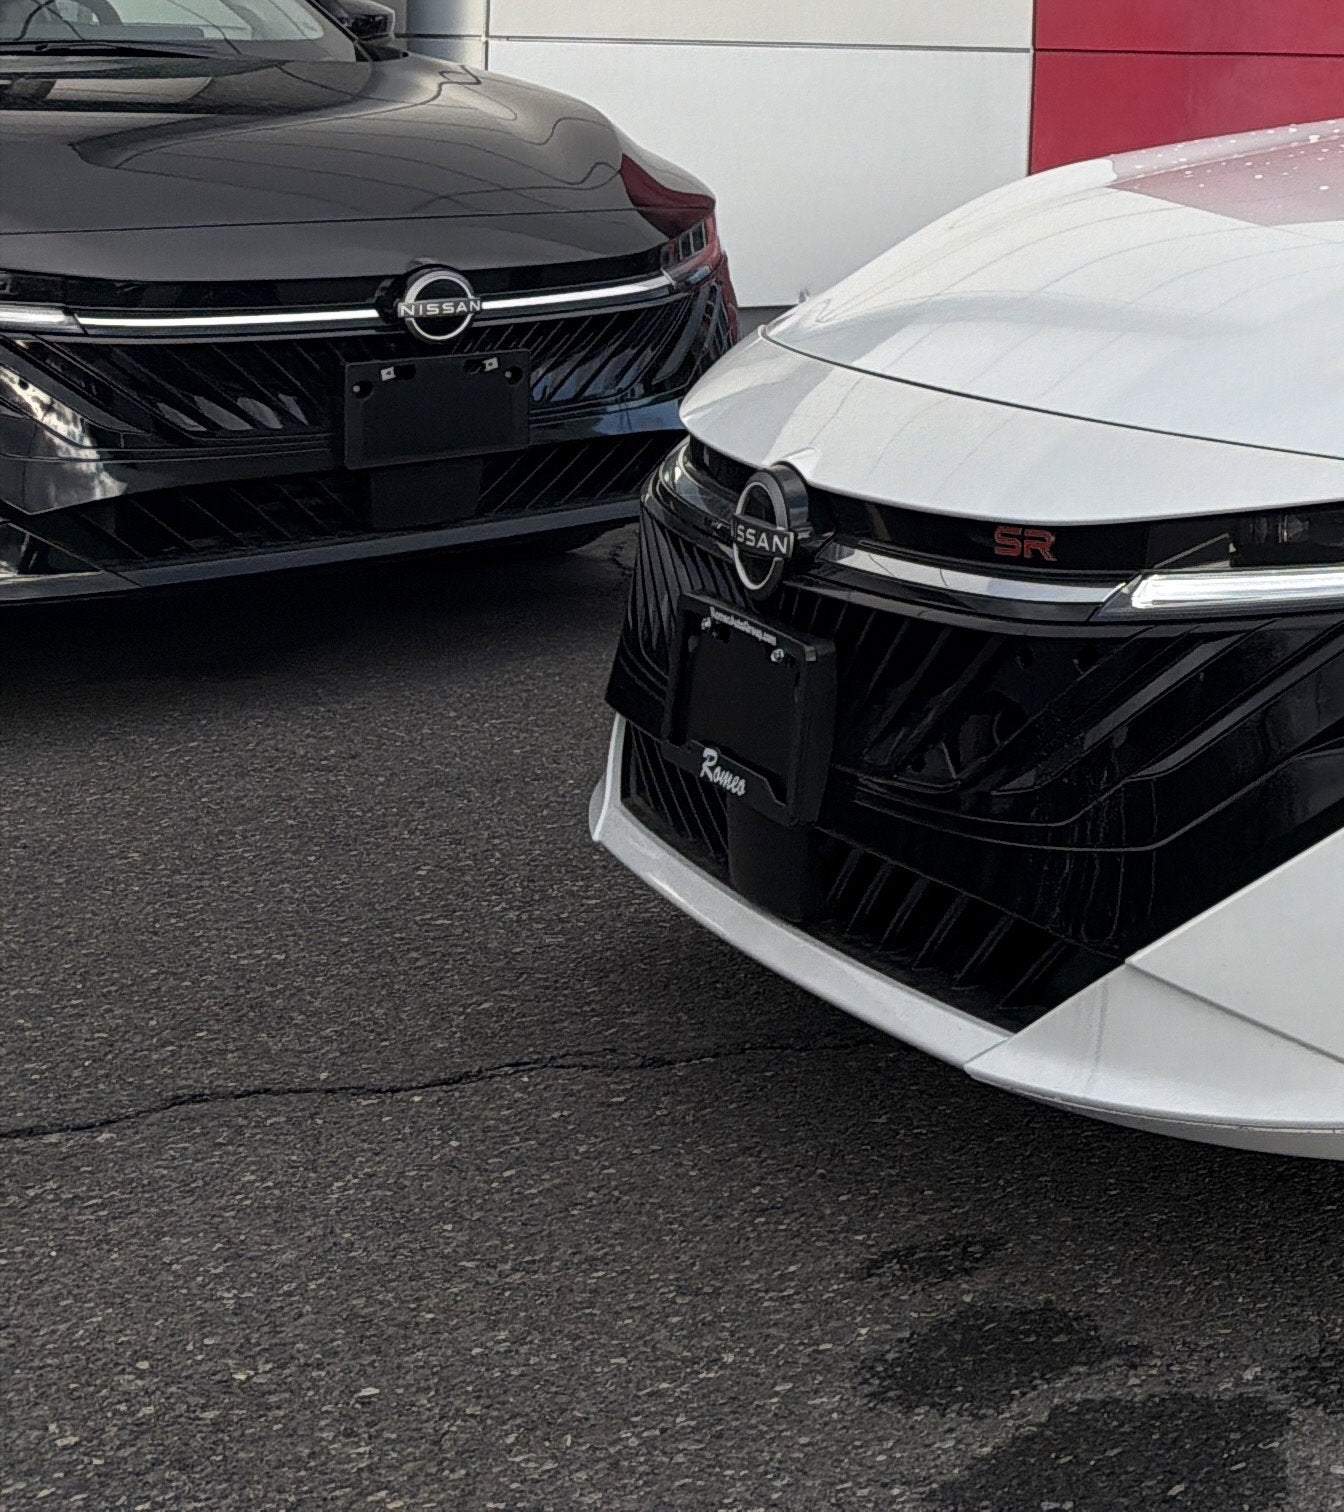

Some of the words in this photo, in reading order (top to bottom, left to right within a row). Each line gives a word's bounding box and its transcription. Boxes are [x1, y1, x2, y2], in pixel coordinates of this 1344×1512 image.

[400, 299, 482, 316] NISSAN
[736, 524, 788, 554] SSAN
[994, 525, 1057, 561] SR
[700, 747, 746, 796] Romeo
